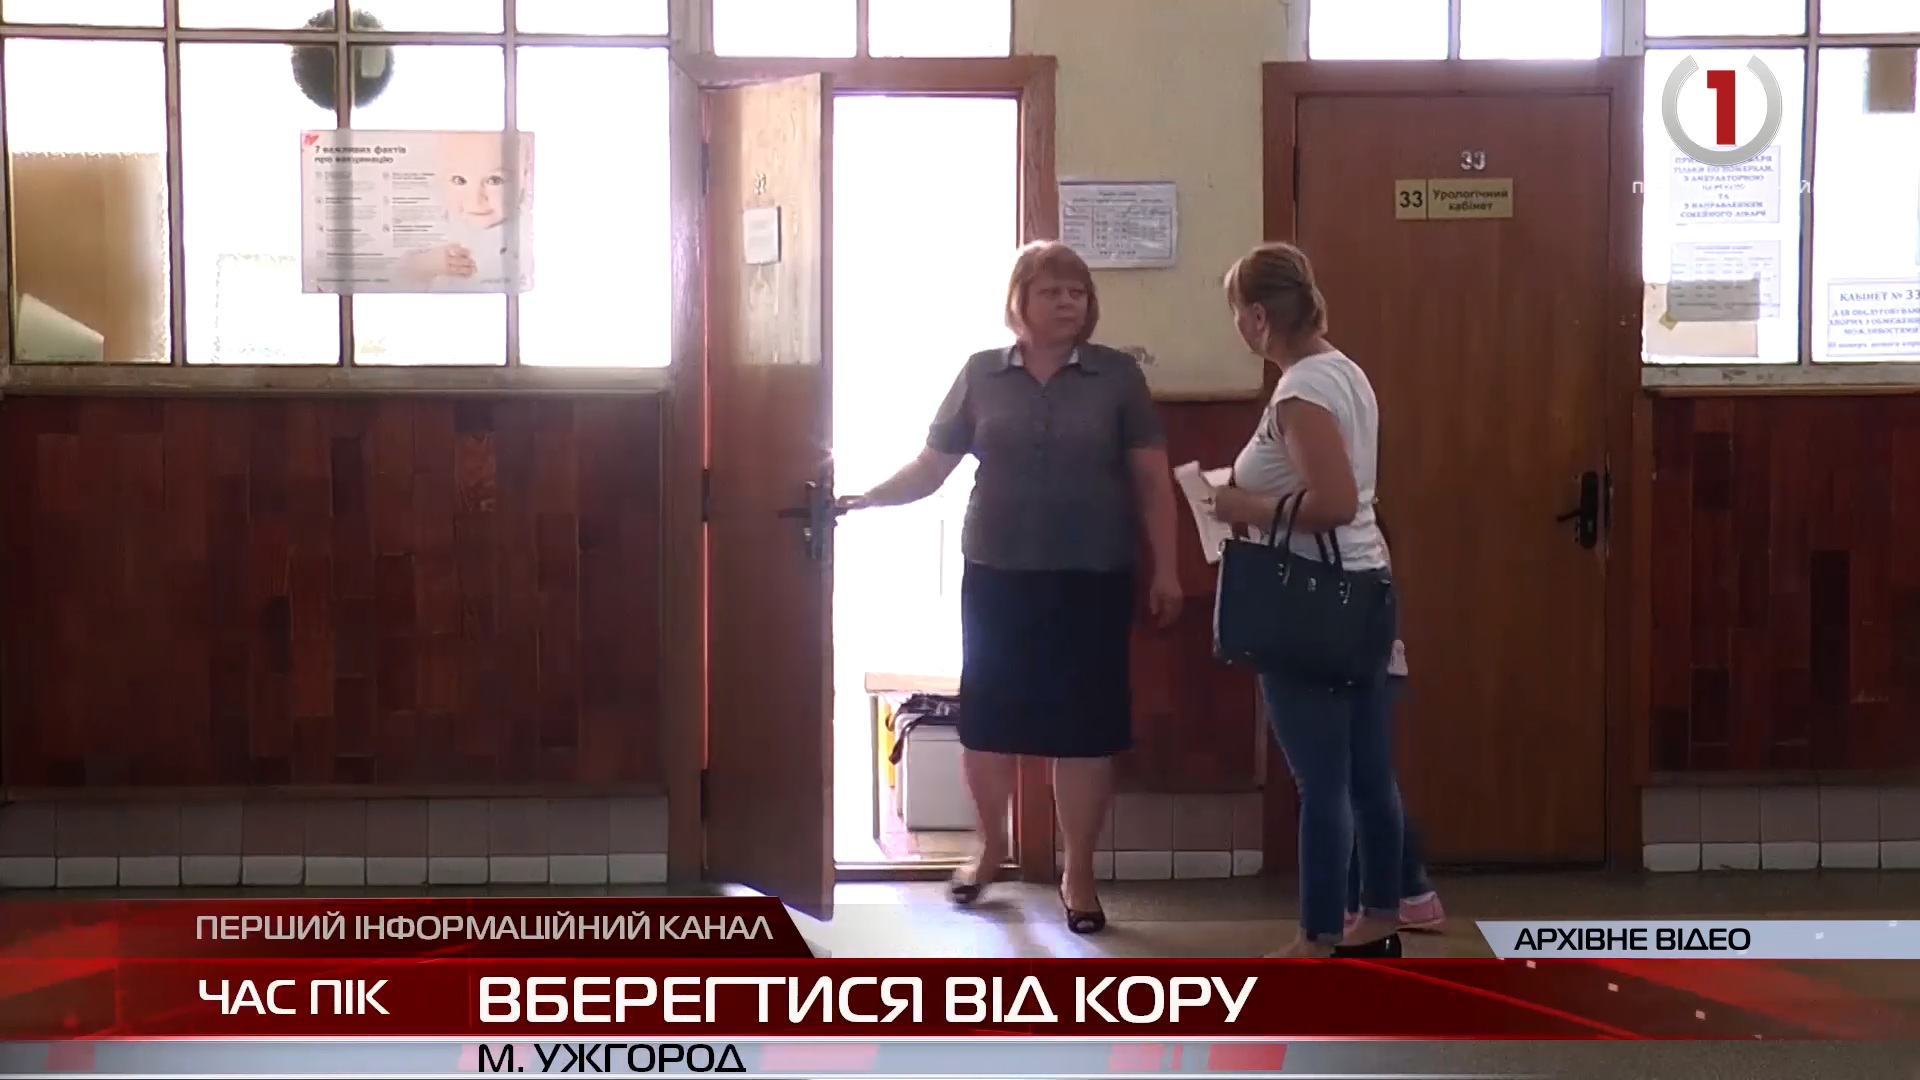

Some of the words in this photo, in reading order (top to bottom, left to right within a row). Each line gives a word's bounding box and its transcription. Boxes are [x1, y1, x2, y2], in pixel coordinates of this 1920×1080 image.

[1400, 191, 1423, 208] 33
[1433, 189, 1508, 200] Урологічний
[1449, 201, 1493, 211] кабінет
